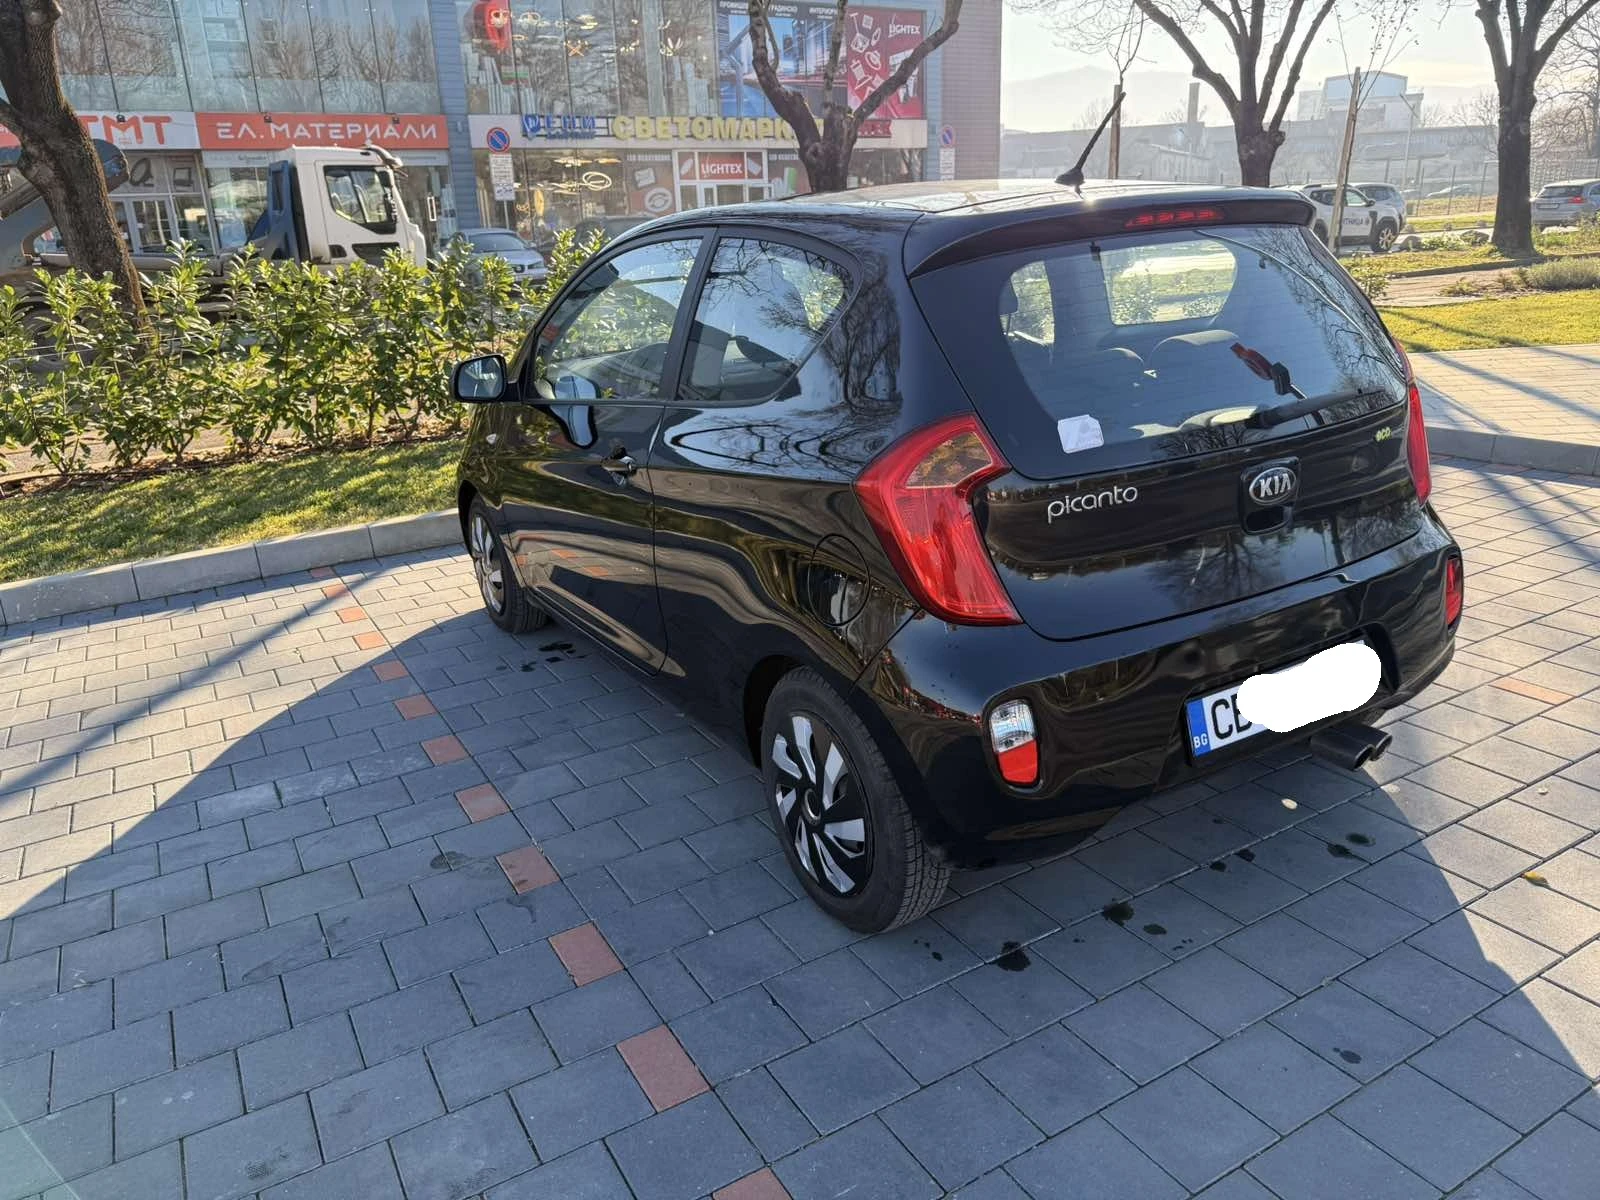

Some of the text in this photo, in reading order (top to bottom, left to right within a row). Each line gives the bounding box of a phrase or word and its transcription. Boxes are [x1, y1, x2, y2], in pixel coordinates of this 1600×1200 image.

[612, 115, 824, 141] СВЕТОМАРК
[701, 159, 743, 176] LIGHTEX
[1258, 473, 1291, 498] KIA
[1047, 485, 1138, 524] picanto
[1193, 733, 1208, 749] BG
